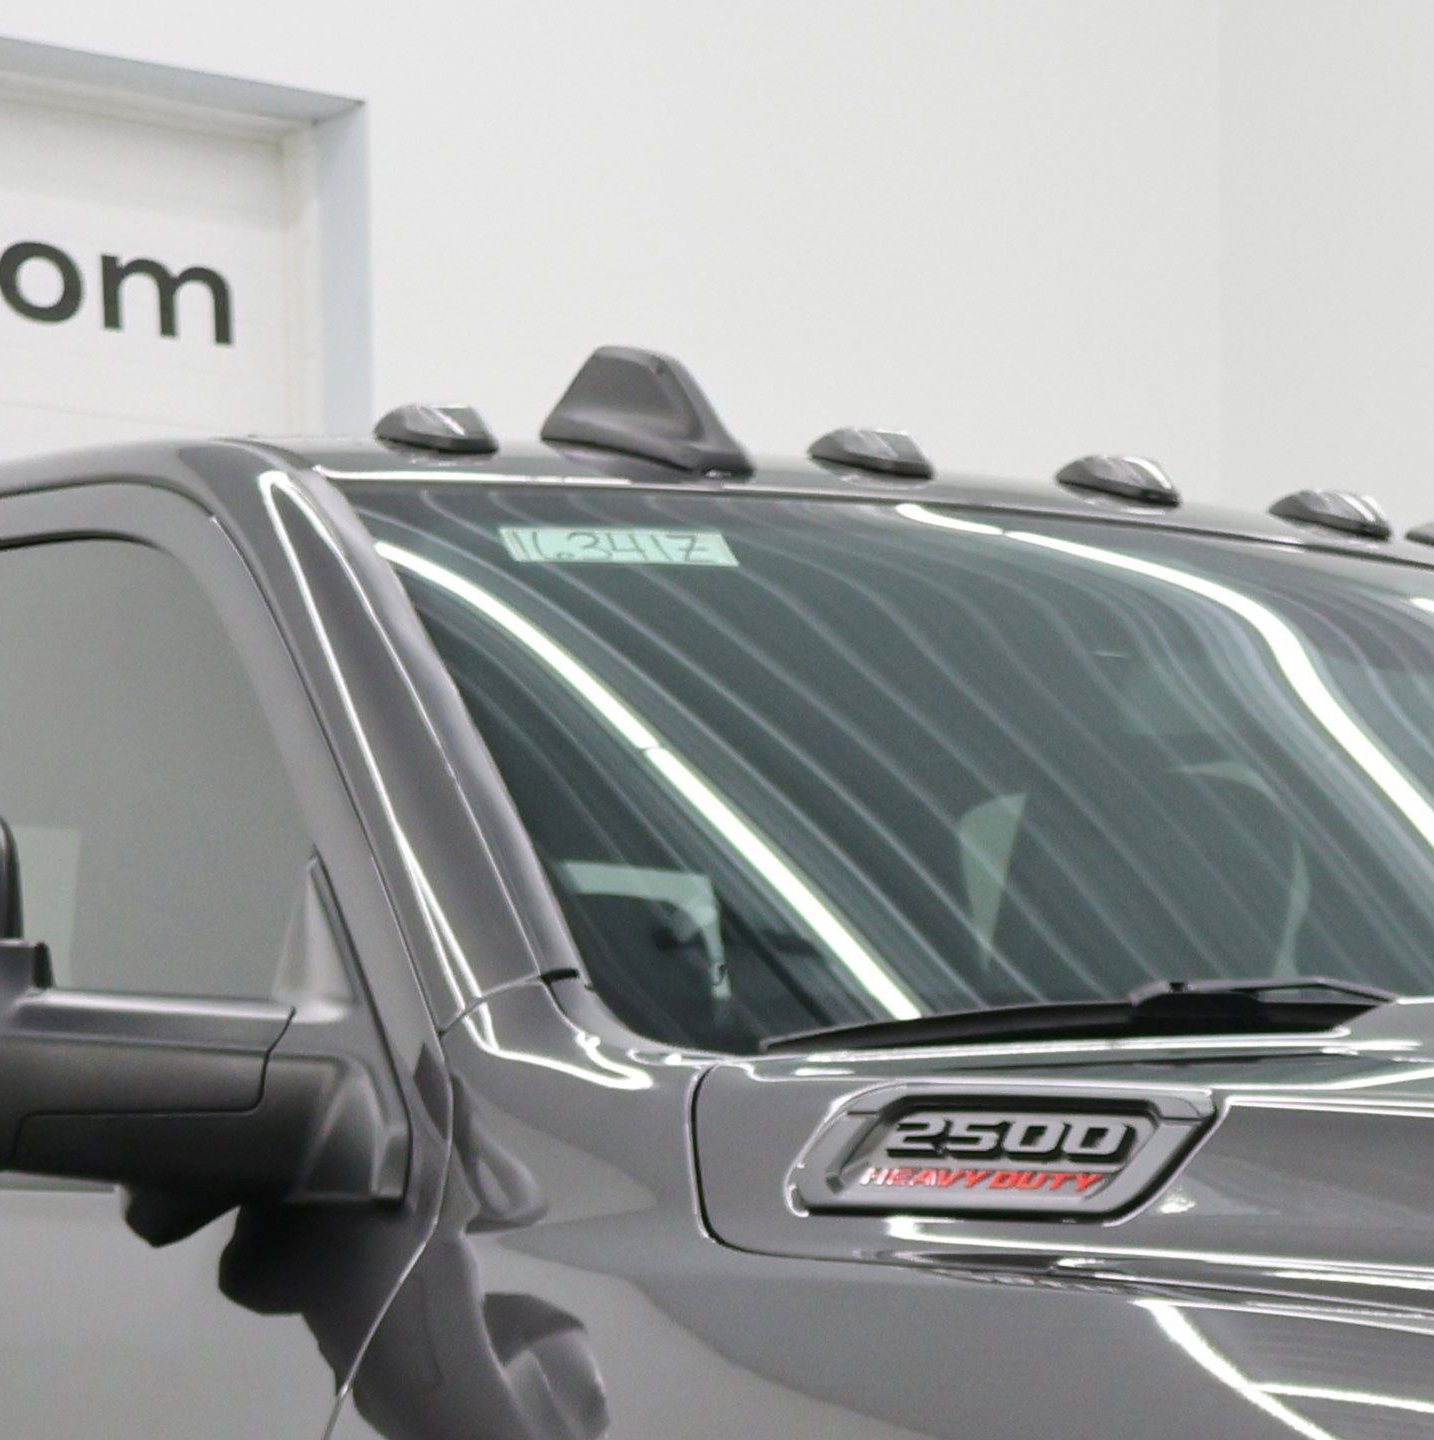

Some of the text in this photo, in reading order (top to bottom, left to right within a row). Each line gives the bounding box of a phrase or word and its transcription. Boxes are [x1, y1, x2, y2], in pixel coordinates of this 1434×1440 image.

[886, 1116, 1134, 1161] 2500
[859, 1167, 1102, 1192] HEAVY DUTY
